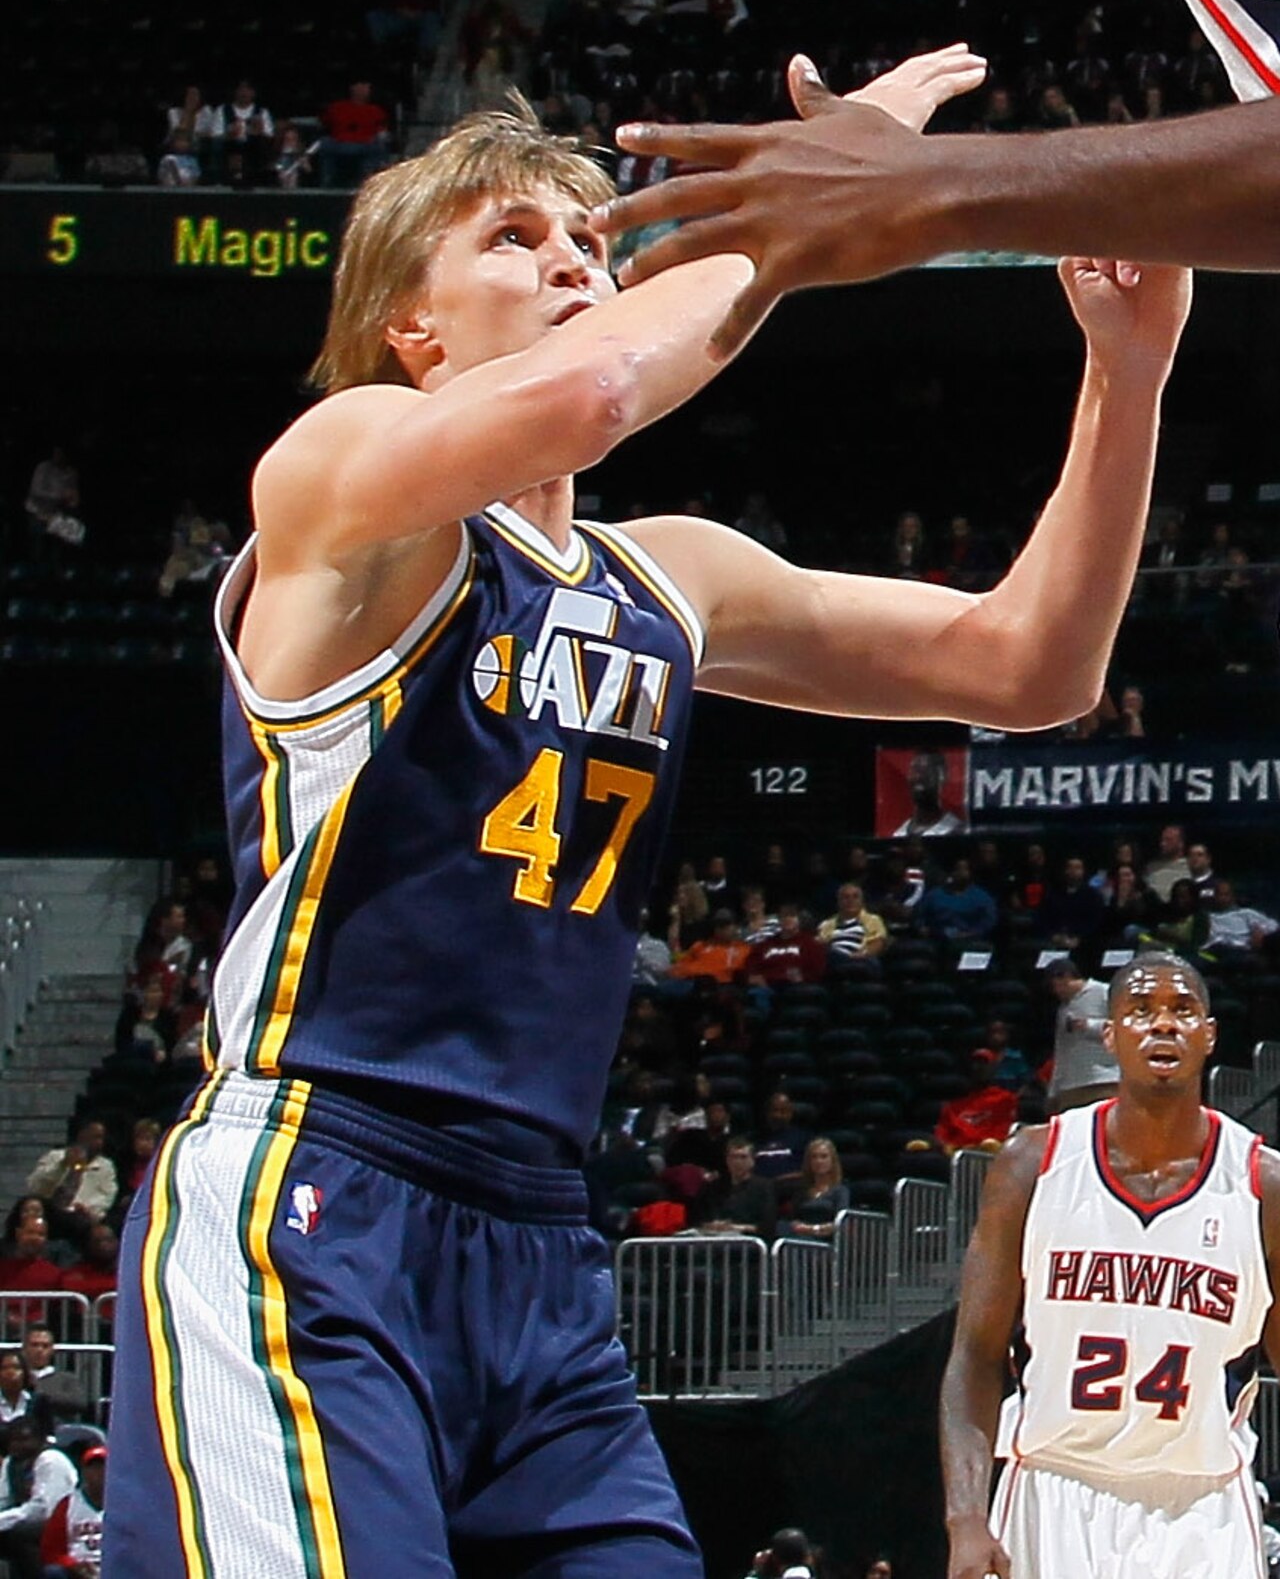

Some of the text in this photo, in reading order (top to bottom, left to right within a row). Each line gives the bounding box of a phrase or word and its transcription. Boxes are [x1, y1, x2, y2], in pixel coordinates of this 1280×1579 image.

[48, 215, 330, 276] 5 Magic
[749, 765, 809, 795] 122
[480, 747, 656, 914] 47
[1045, 1250, 1240, 1325] HAWKS
[1070, 1334, 1197, 1420] 24
